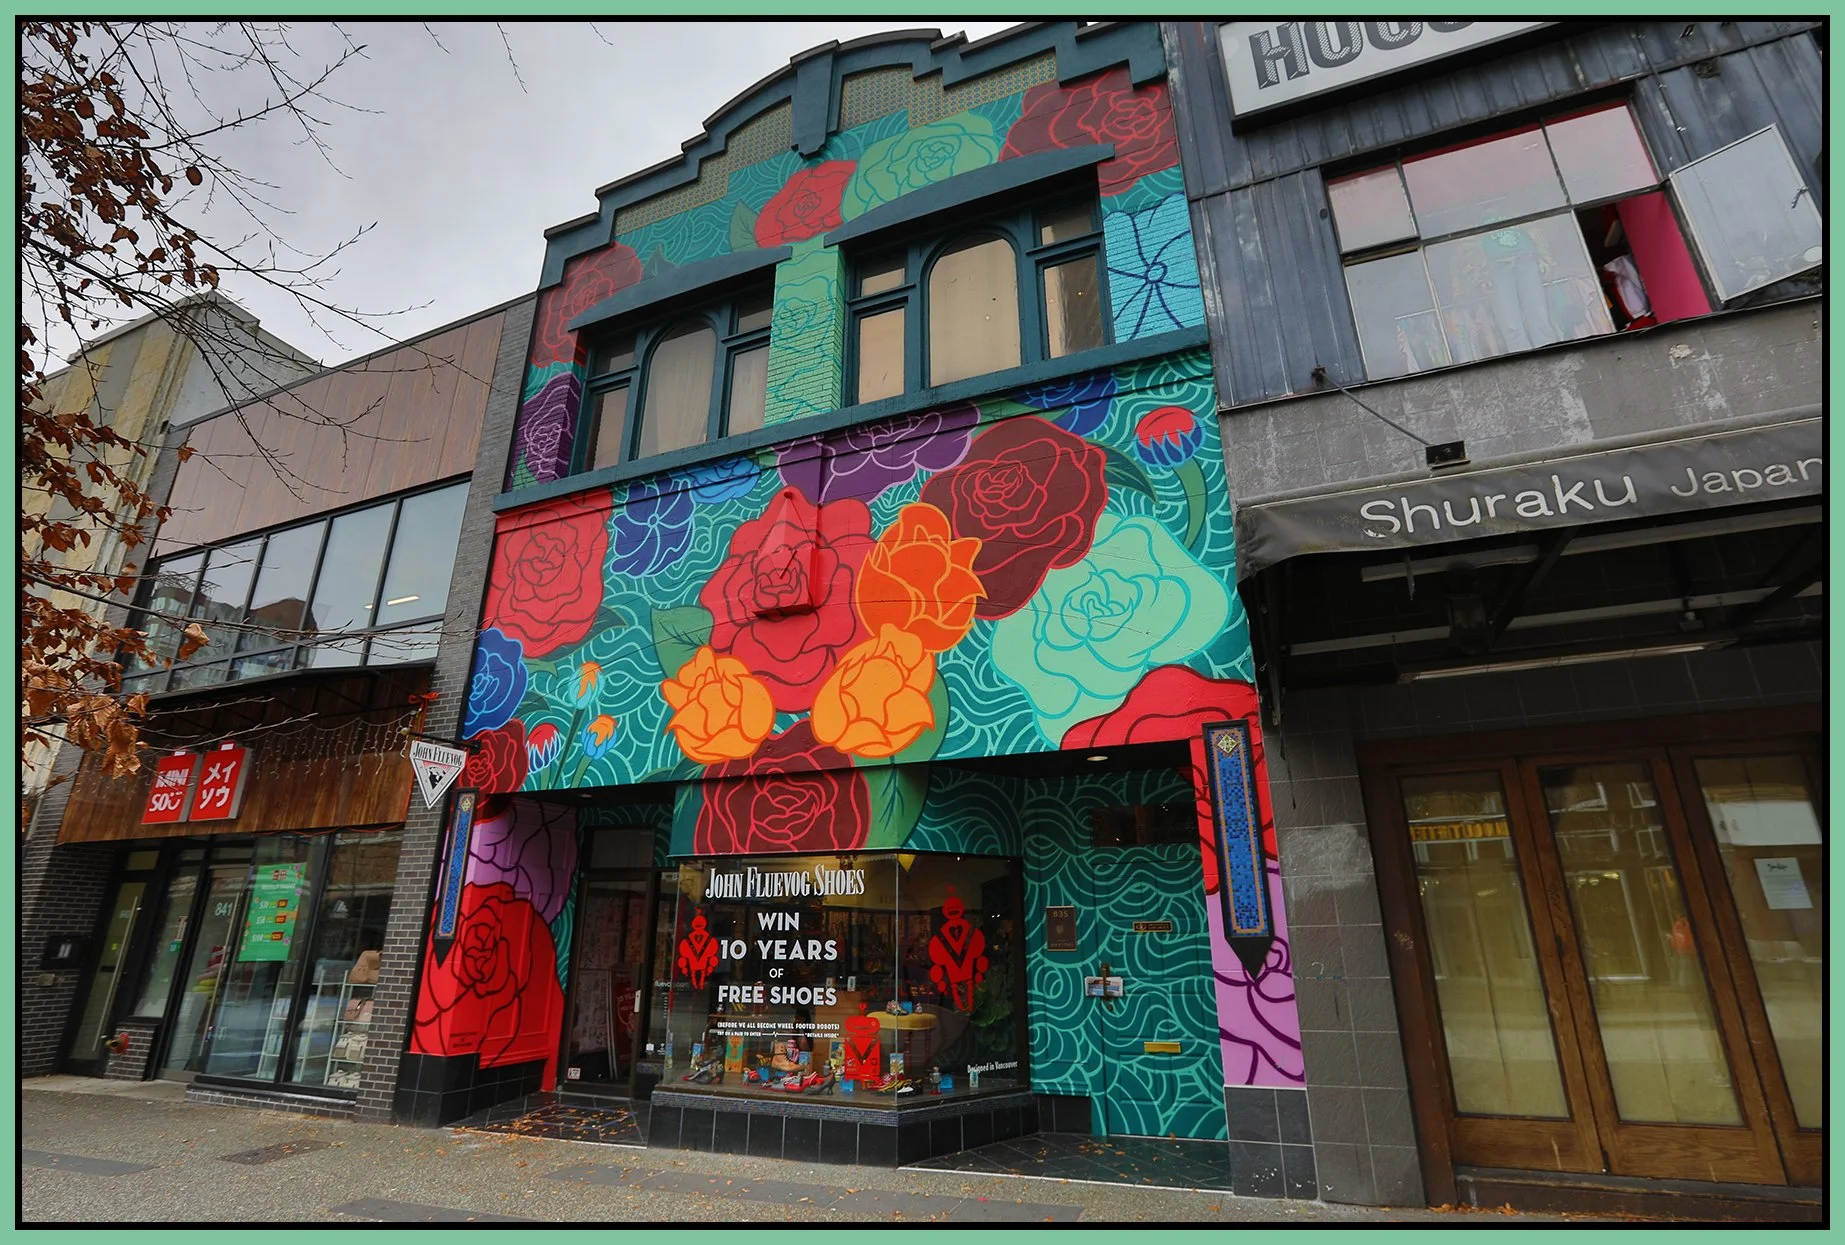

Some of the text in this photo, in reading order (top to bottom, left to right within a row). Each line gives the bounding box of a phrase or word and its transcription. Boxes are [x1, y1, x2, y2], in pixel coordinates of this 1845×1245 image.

[1360, 457, 1822, 538] Shuraku Japan
[413, 742, 432, 760] JOHN
[155, 768, 190, 788] MINI
[203, 761, 237, 786] メイ
[200, 785, 231, 810] ソウ
[705, 863, 866, 899] JOHN FLUEVOG SHOES
[215, 902, 233, 916] 841
[757, 912, 800, 931] WIN
[720, 939, 838, 961] 10 YEARS
[769, 968, 784, 978] OF
[718, 985, 837, 1006] FREE SHOES
[717, 1021, 738, 1029] (BEFORE
[777, 1022, 794, 1030] WHEEL
[967, 1061, 1018, 1073] Designed in Vancouver
